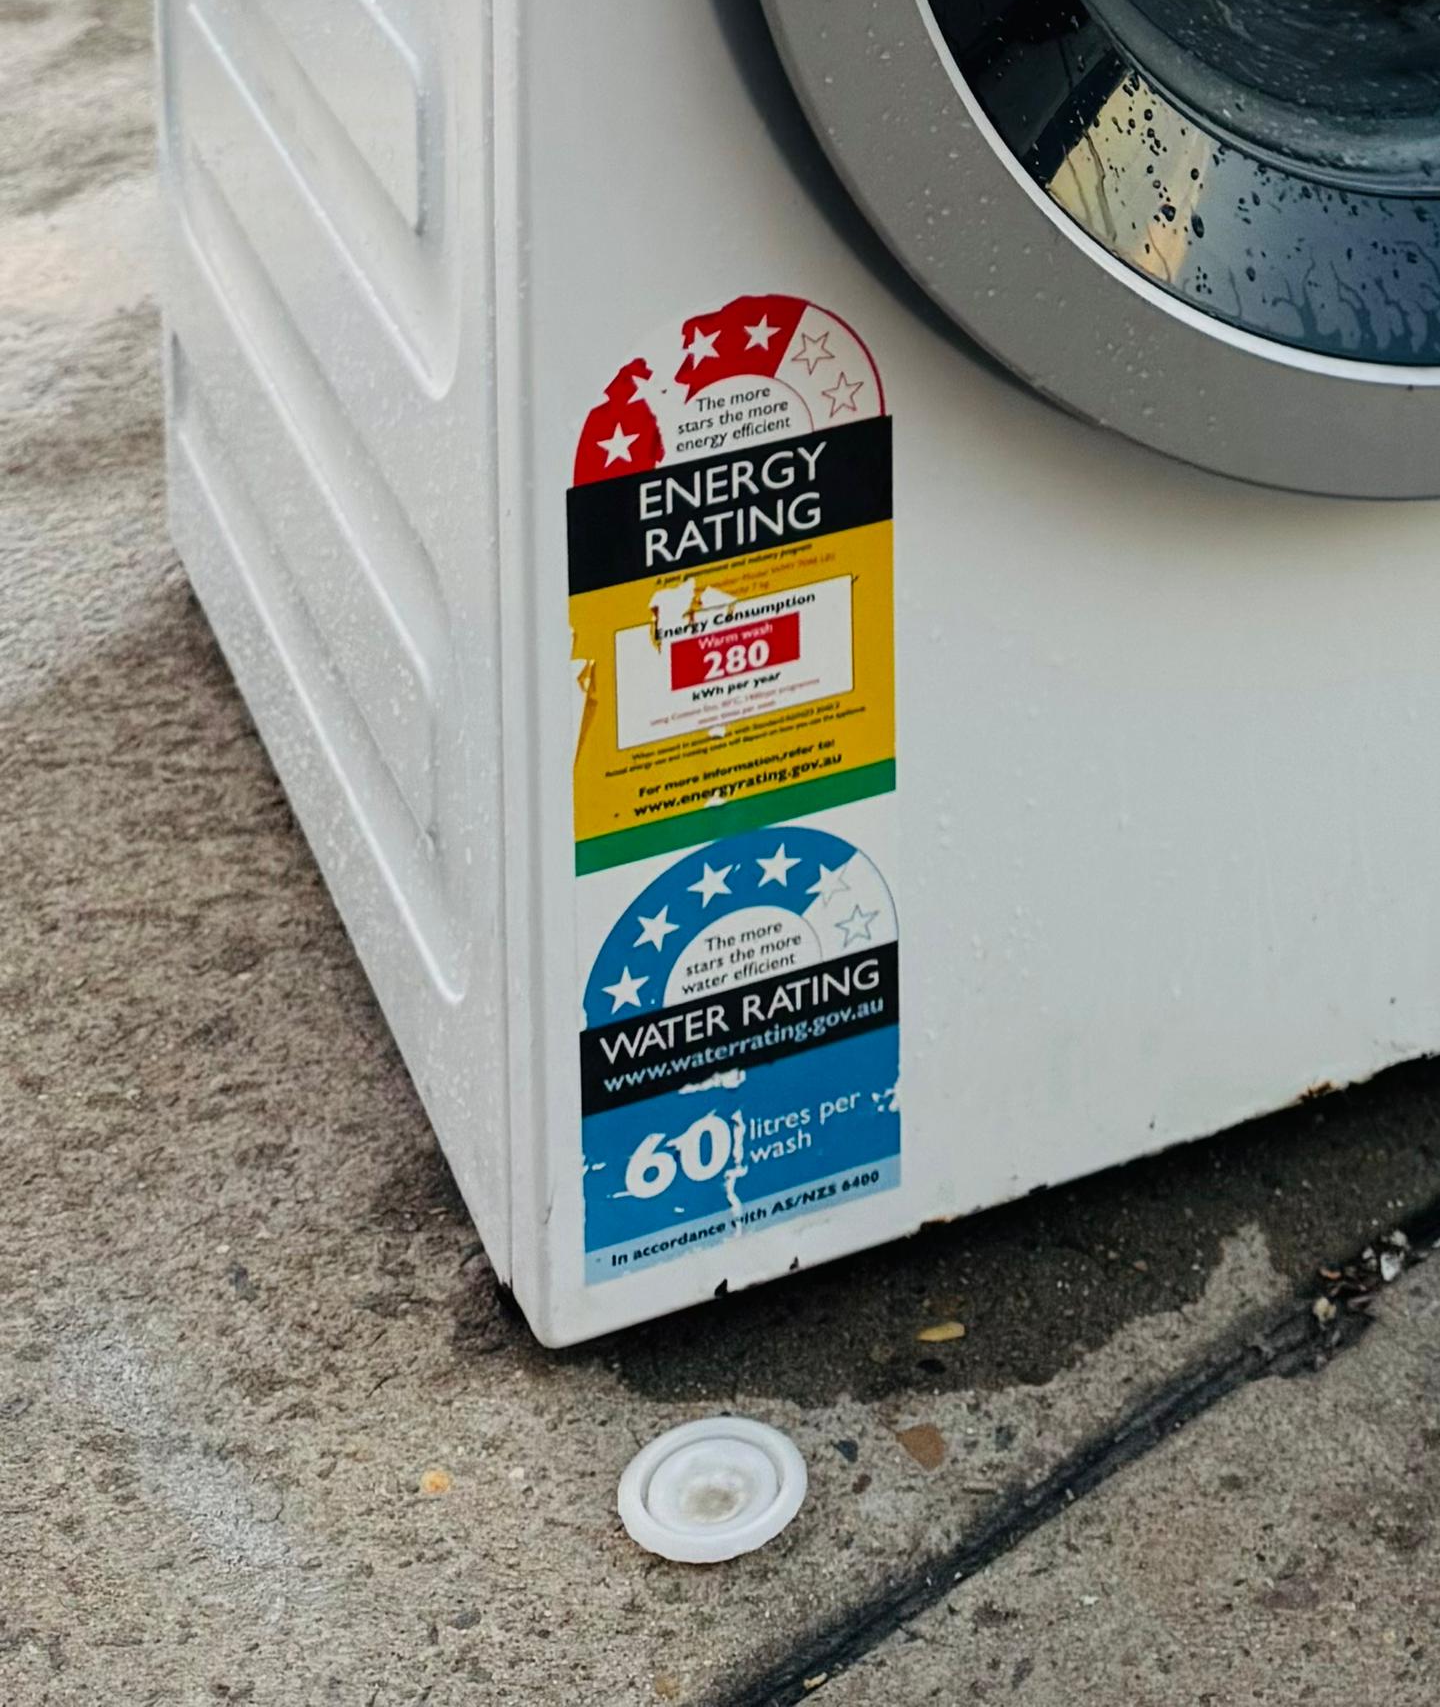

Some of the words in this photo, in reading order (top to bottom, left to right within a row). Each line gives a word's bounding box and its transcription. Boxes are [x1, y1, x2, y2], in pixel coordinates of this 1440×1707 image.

[677, 416, 714, 435] stars
[719, 409, 744, 426] the
[748, 400, 789, 419] more
[696, 396, 726, 413] The
[730, 387, 771, 406] more
[676, 431, 728, 453] energy
[732, 417, 791, 440] efficient
[638, 441, 828, 521] ENERGY
[645, 491, 822, 567] RATING
[655, 618, 710, 640] Energy
[713, 592, 816, 626] Consumption
[698, 630, 739, 650] Warm
[740, 621, 774, 639] wash
[703, 638, 771, 682] 280
[692, 685, 724, 702] kWh
[727, 678, 749, 695] per
[752, 671, 782, 689] year
[634, 753, 843, 817] www.energyrating.gov.au
[638, 783, 662, 798] For
[664, 773, 700, 791] more
[686, 957, 724, 977] stars
[730, 948, 755, 964] the
[760, 934, 802, 955] more
[705, 935, 736, 952] The
[740, 922, 783, 943] more
[681, 972, 728, 995] water
[733, 952, 797, 981] efficient
[599, 1004, 730, 1066] WATER
[741, 958, 881, 1027] RATING
[603, 998, 884, 1093] www.waterrating.gov.au
[750, 1107, 811, 1140] litres
[819, 1092, 861, 1125] per
[624, 1112, 732, 1199] 60
[750, 1129, 812, 1164] wash
[611, 1252, 628, 1267] In
[633, 1222, 726, 1261] accordance
[771, 1184, 837, 1216] AS/NZS
[841, 1170, 880, 1192] 6400
